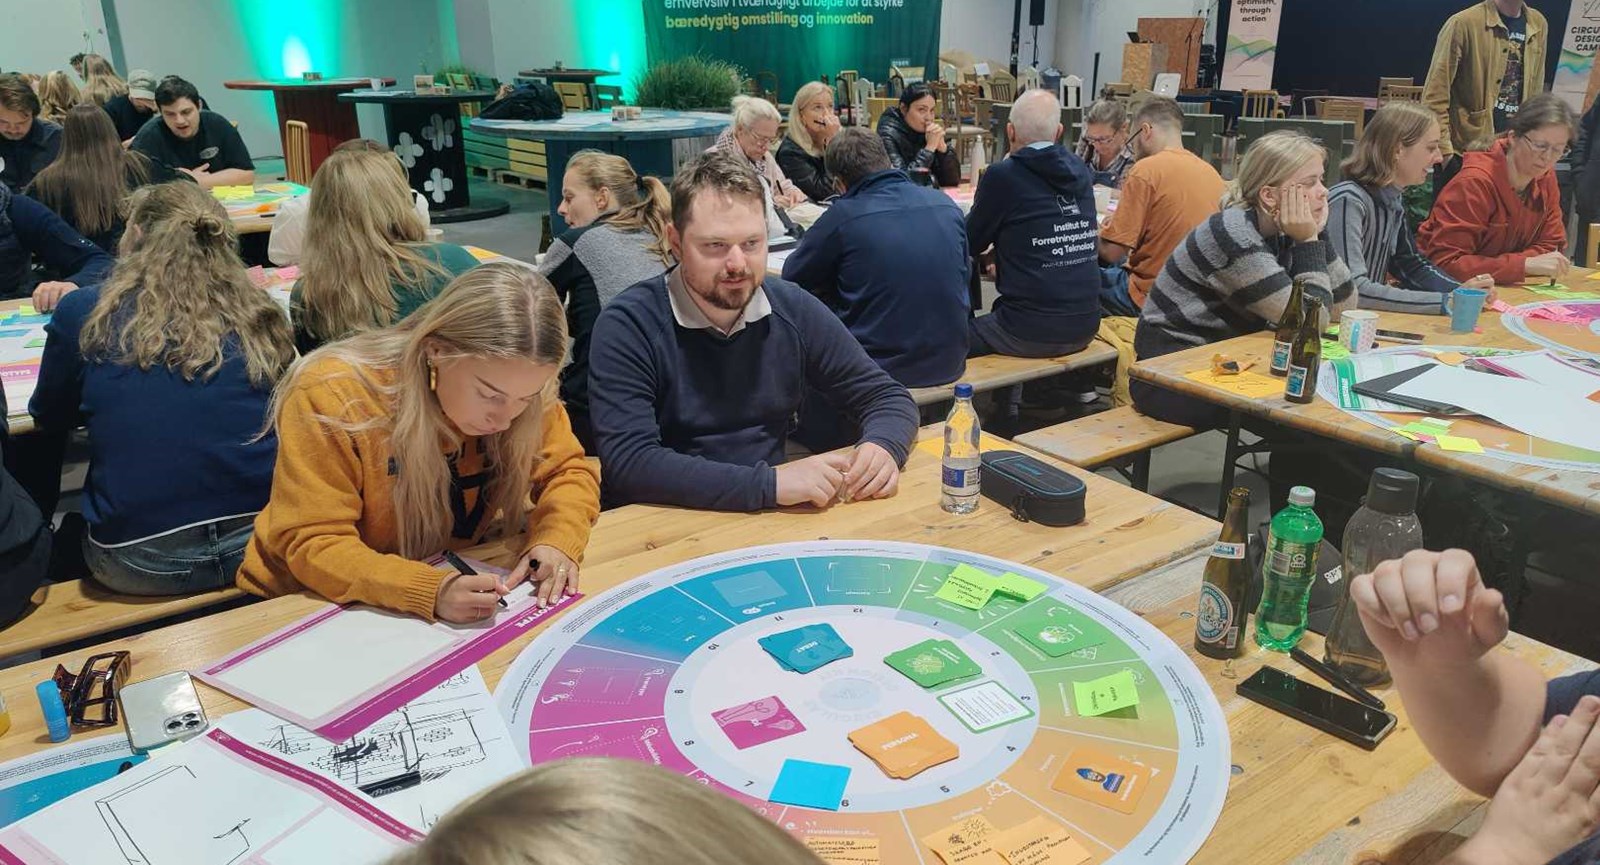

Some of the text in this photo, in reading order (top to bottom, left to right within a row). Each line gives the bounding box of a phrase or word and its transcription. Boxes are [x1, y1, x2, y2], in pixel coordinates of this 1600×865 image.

[1240, 7, 1271, 15] through
[665, 11, 874, 31] bæredygtig omstilling og innovation
[1053, 220, 1090, 232] Institut for
[1052, 247, 1064, 256] og
[0, 369, 32, 377] OTYPE
